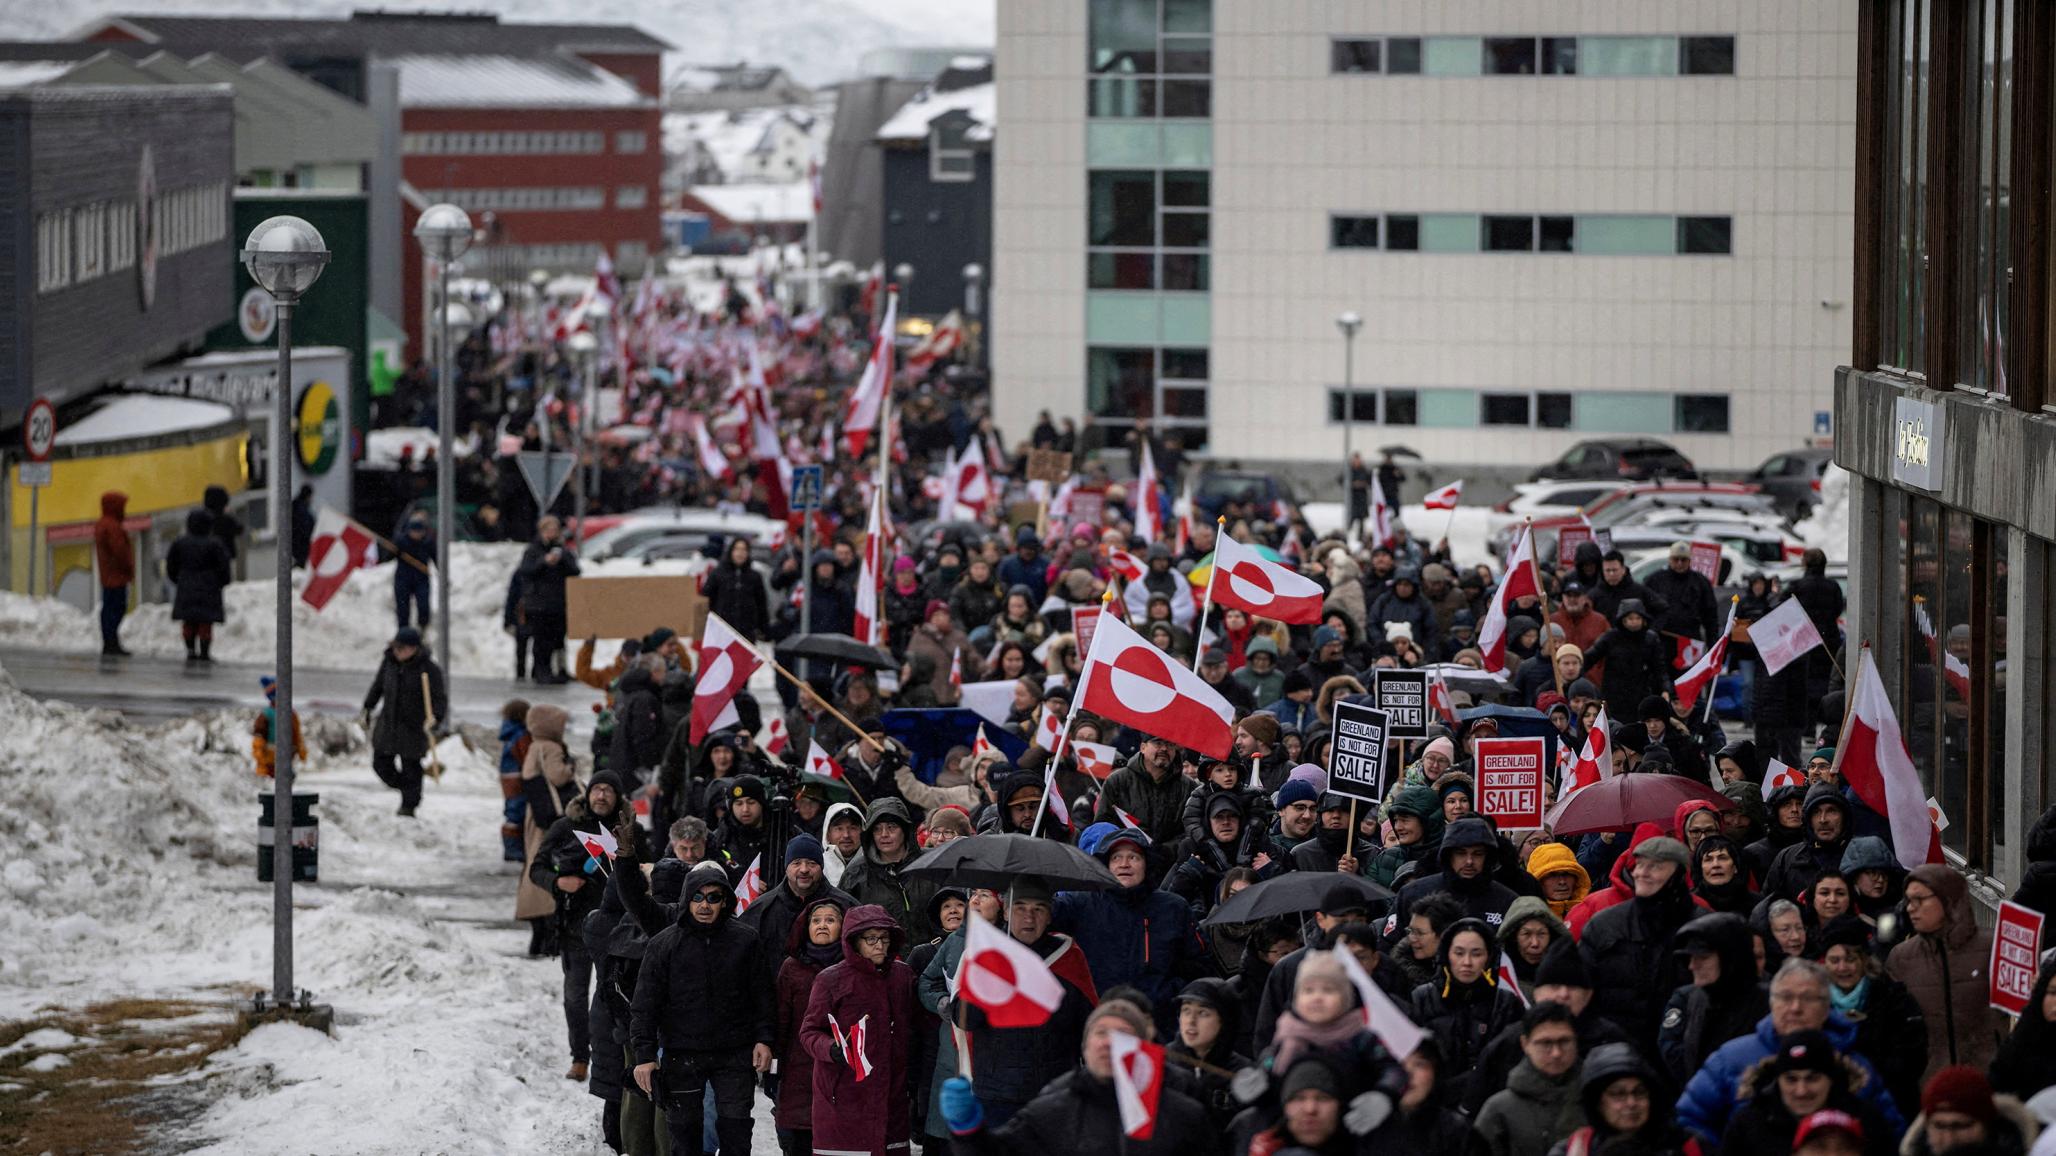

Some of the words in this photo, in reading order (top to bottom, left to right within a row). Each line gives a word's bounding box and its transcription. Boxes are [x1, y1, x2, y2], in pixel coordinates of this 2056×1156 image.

[32, 416, 52, 443] 20
[1383, 682, 1420, 691] GREENLAND
[1383, 696, 1390, 704] IS
[1392, 696, 1405, 704] NOT
[1407, 696, 1420, 704] FOR
[1340, 720, 1380, 739] GREENLAND
[1339, 738, 1346, 749] IS
[1348, 739, 1362, 753] NOT
[1363, 743, 1378, 756] FOR
[1336, 755, 1376, 784] SALE!
[1486, 756, 1535, 768] GREENLAND
[1486, 774, 1494, 785] IS
[1497, 773, 1515, 785] NOT
[1518, 773, 1535, 784] FOR
[1485, 790, 1535, 813] SALE!
[2001, 922, 2033, 946] GREENLAND
[2020, 949, 2032, 965] FOR
[1999, 962, 2031, 998] SALE!
